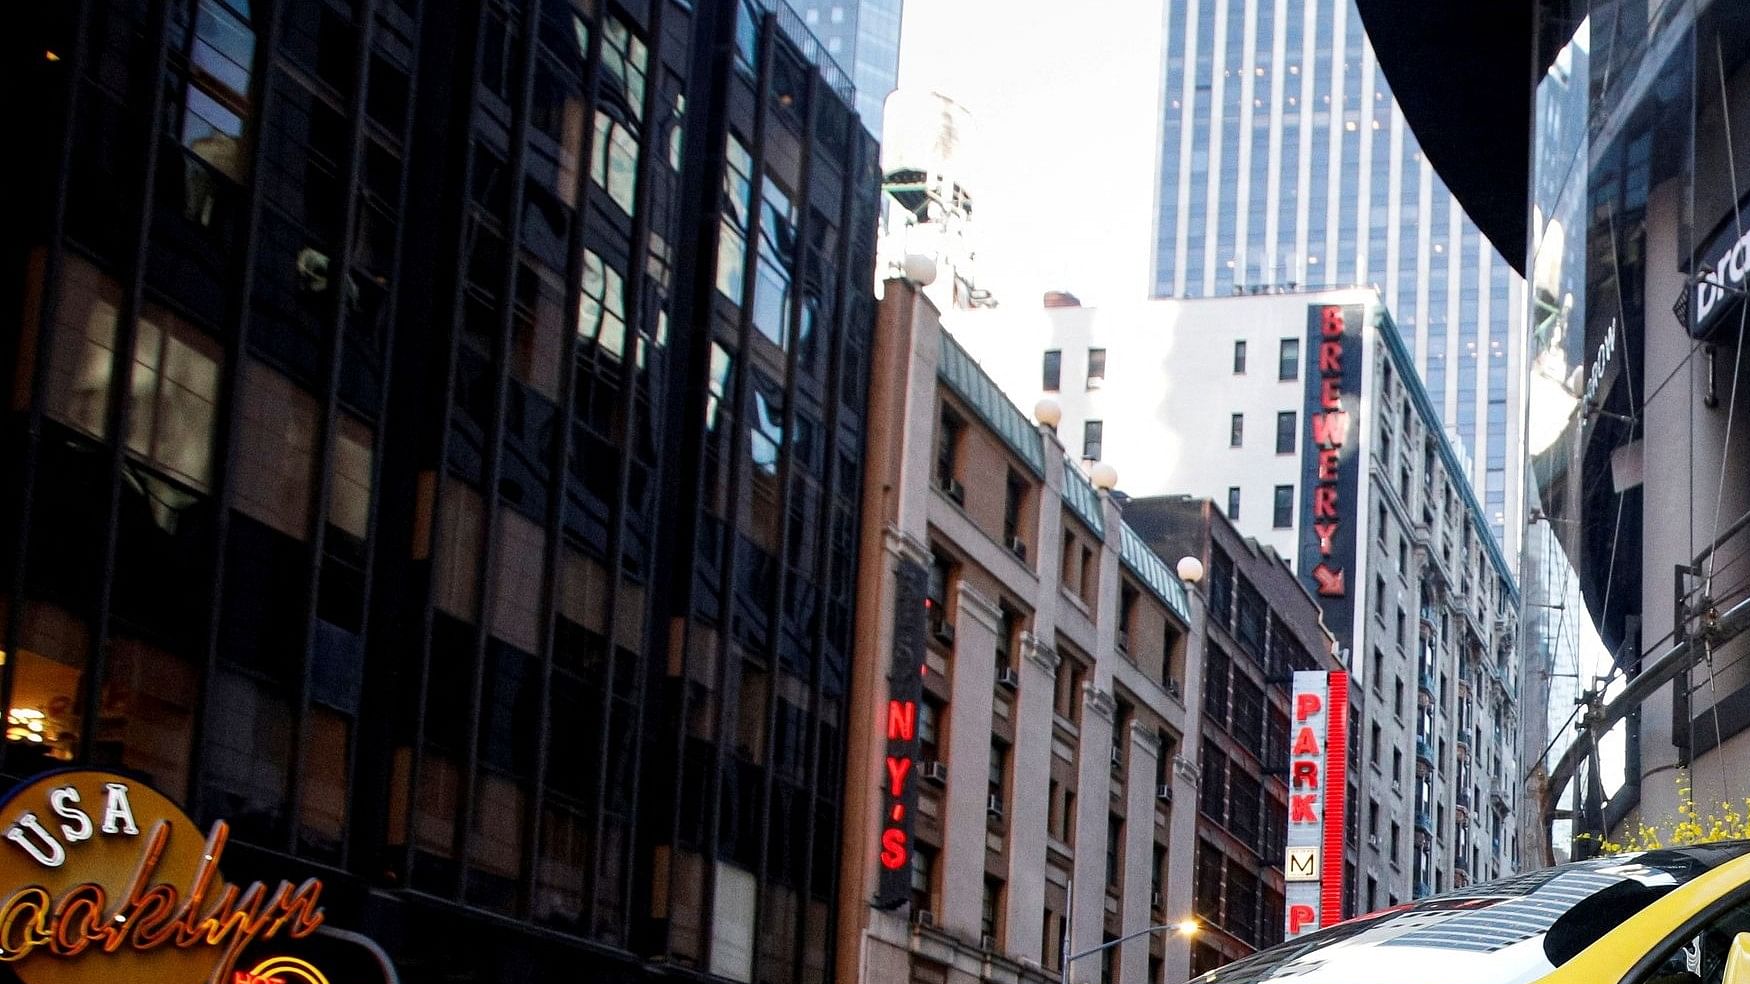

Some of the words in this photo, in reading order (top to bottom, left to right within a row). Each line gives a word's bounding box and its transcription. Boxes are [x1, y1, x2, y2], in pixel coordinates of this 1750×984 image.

[1312, 305, 1348, 556] BREWERY
[1290, 692, 1321, 824] PARK
[6, 783, 139, 867] USA
